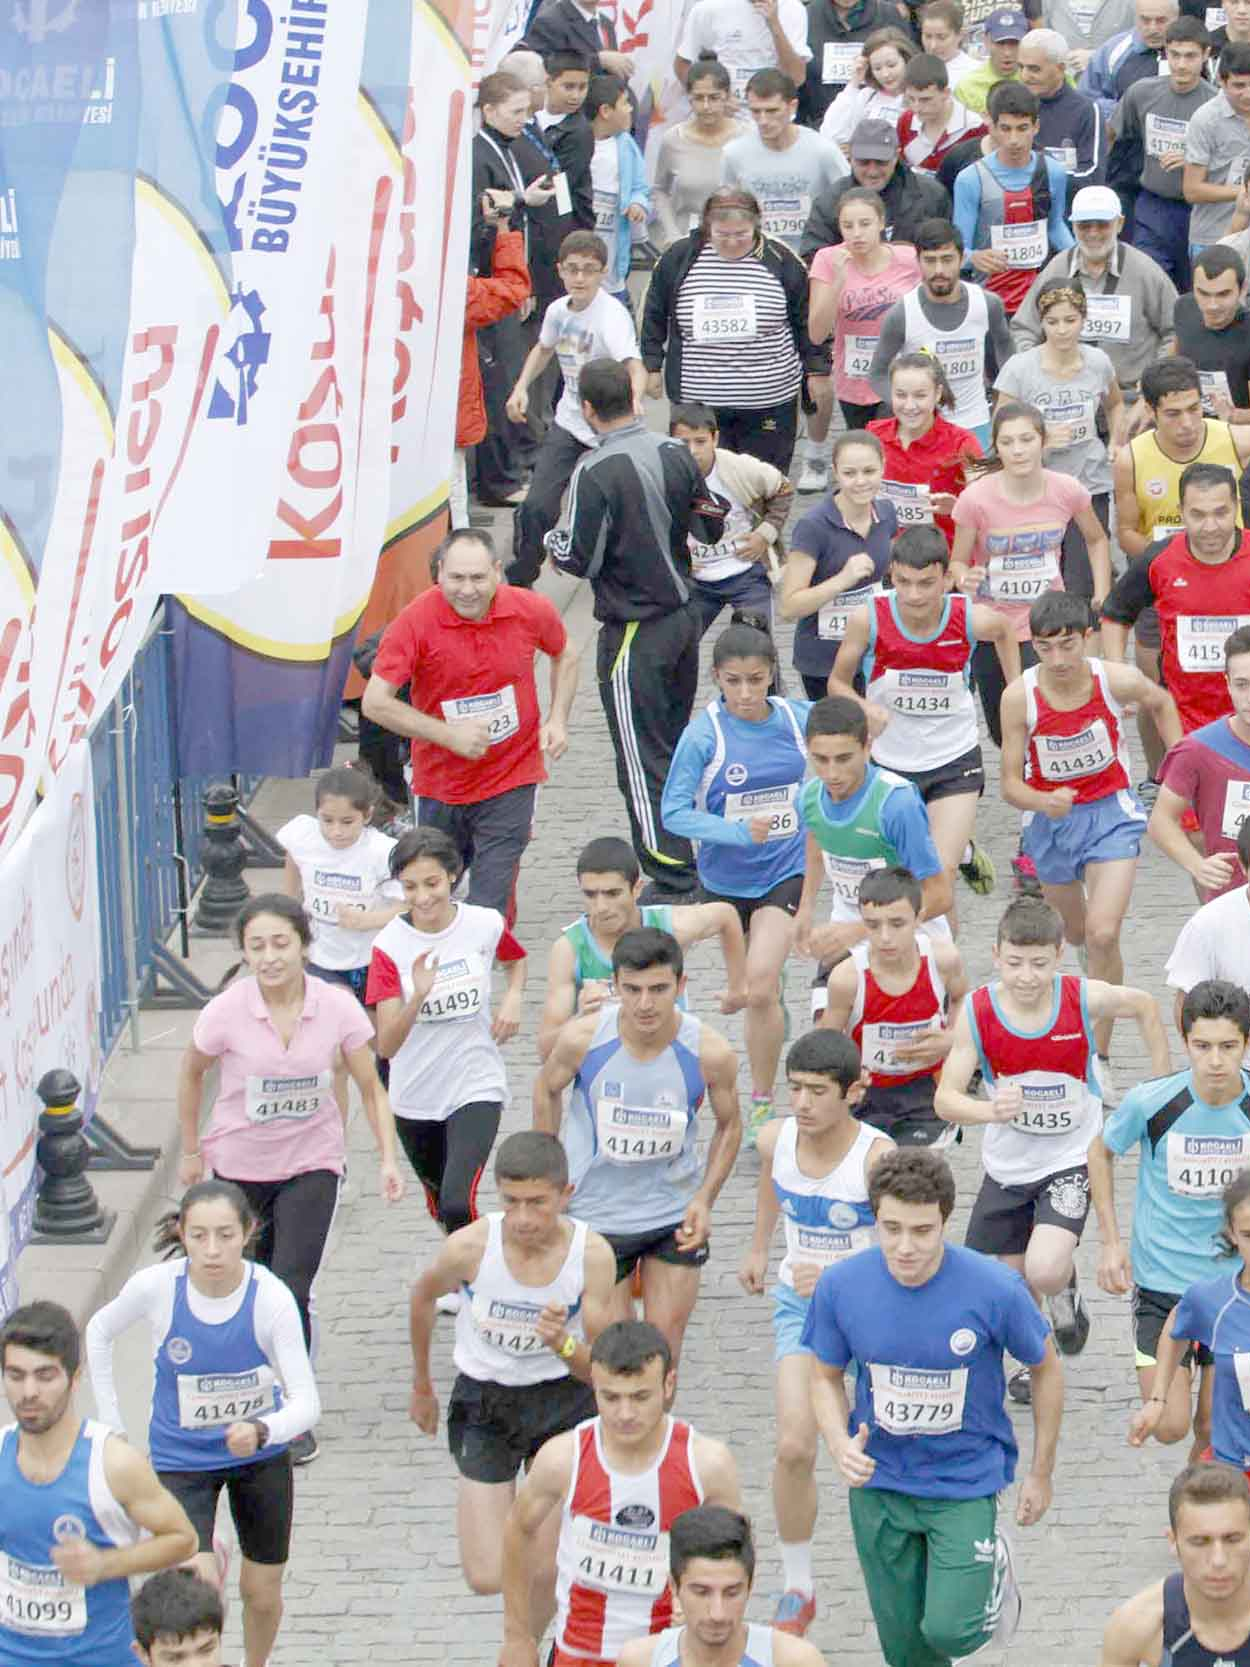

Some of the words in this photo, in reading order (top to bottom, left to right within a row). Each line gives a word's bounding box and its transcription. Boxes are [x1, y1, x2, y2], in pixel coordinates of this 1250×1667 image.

[701, 319, 749, 334] 43582
[894, 696, 950, 711] 41434
[1050, 749, 1105, 774] 41431
[420, 988, 480, 1017] 41492
[256, 1097, 320, 1117] 41483
[606, 1137, 673, 1156] 41414
[1179, 1168, 1238, 1188] 4110
[884, 1400, 954, 1422] 43779
[578, 1554, 655, 1588] 41411
